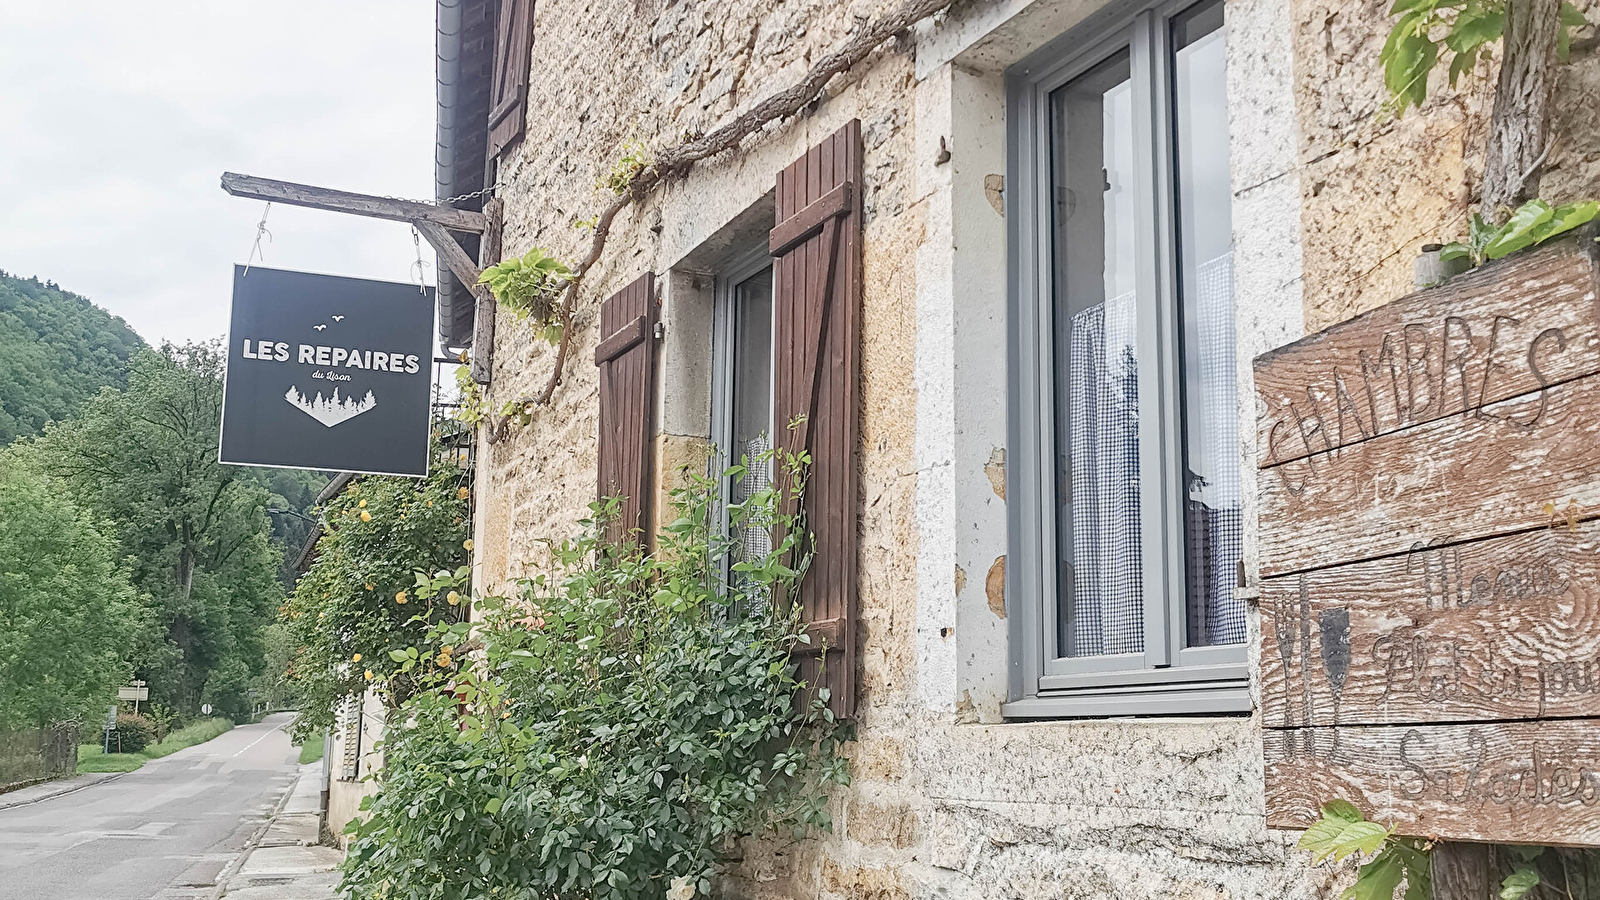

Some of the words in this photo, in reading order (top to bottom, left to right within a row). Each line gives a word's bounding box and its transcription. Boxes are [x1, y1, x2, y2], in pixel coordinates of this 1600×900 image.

[243, 339, 290, 362] LES
[298, 344, 420, 375] REPAIRES
[312, 369, 325, 379] du
[326, 370, 351, 382] Lison
[1269, 316, 1566, 496] CHAMBRES
[1407, 535, 1571, 609] Menu
[1537, 656, 1600, 721] jou
